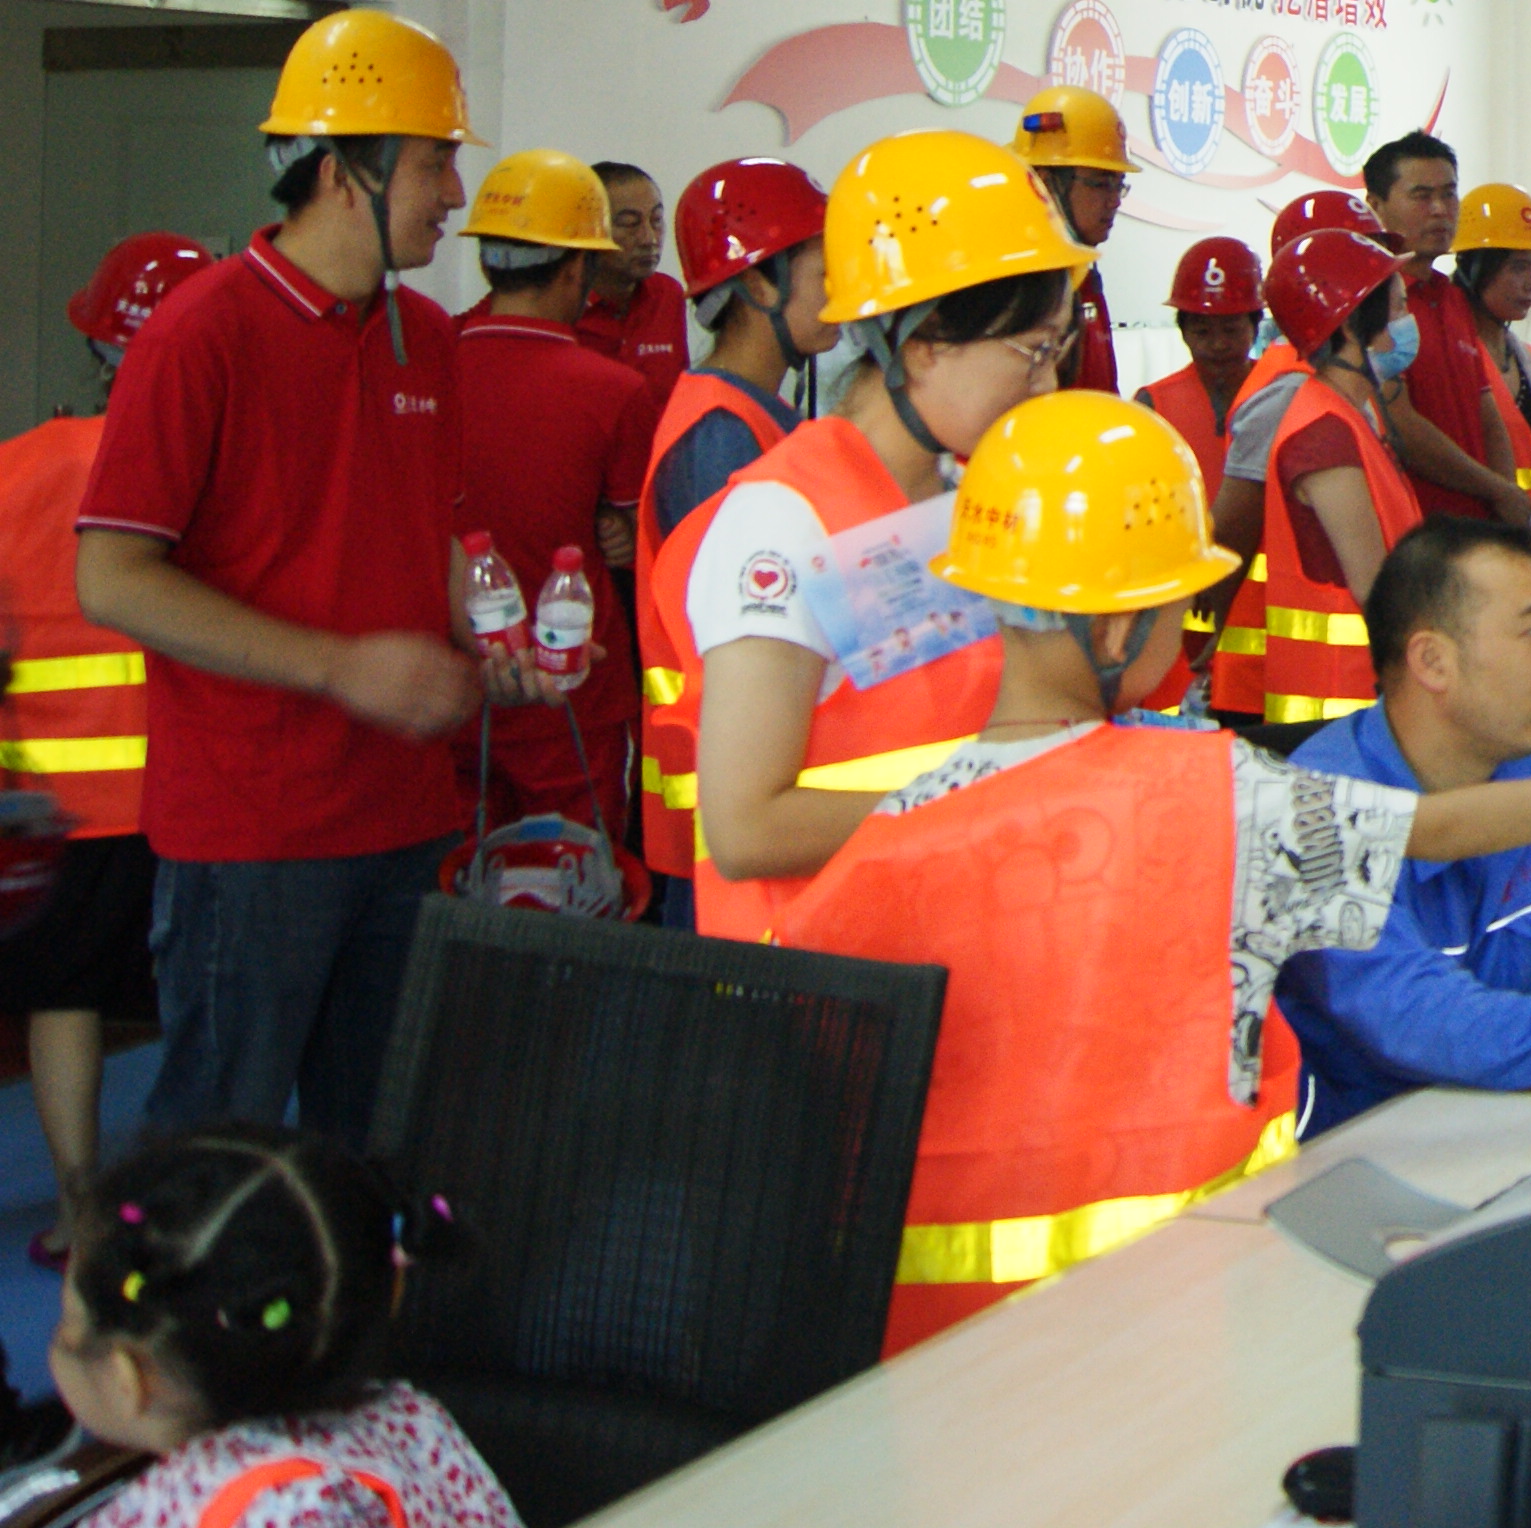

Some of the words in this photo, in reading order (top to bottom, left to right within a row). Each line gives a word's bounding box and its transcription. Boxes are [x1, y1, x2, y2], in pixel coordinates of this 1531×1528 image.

[1168, 78, 1214, 125] 创新
[1255, 75, 1293, 119] 奋斗
[1330, 82, 1369, 125] 发展
